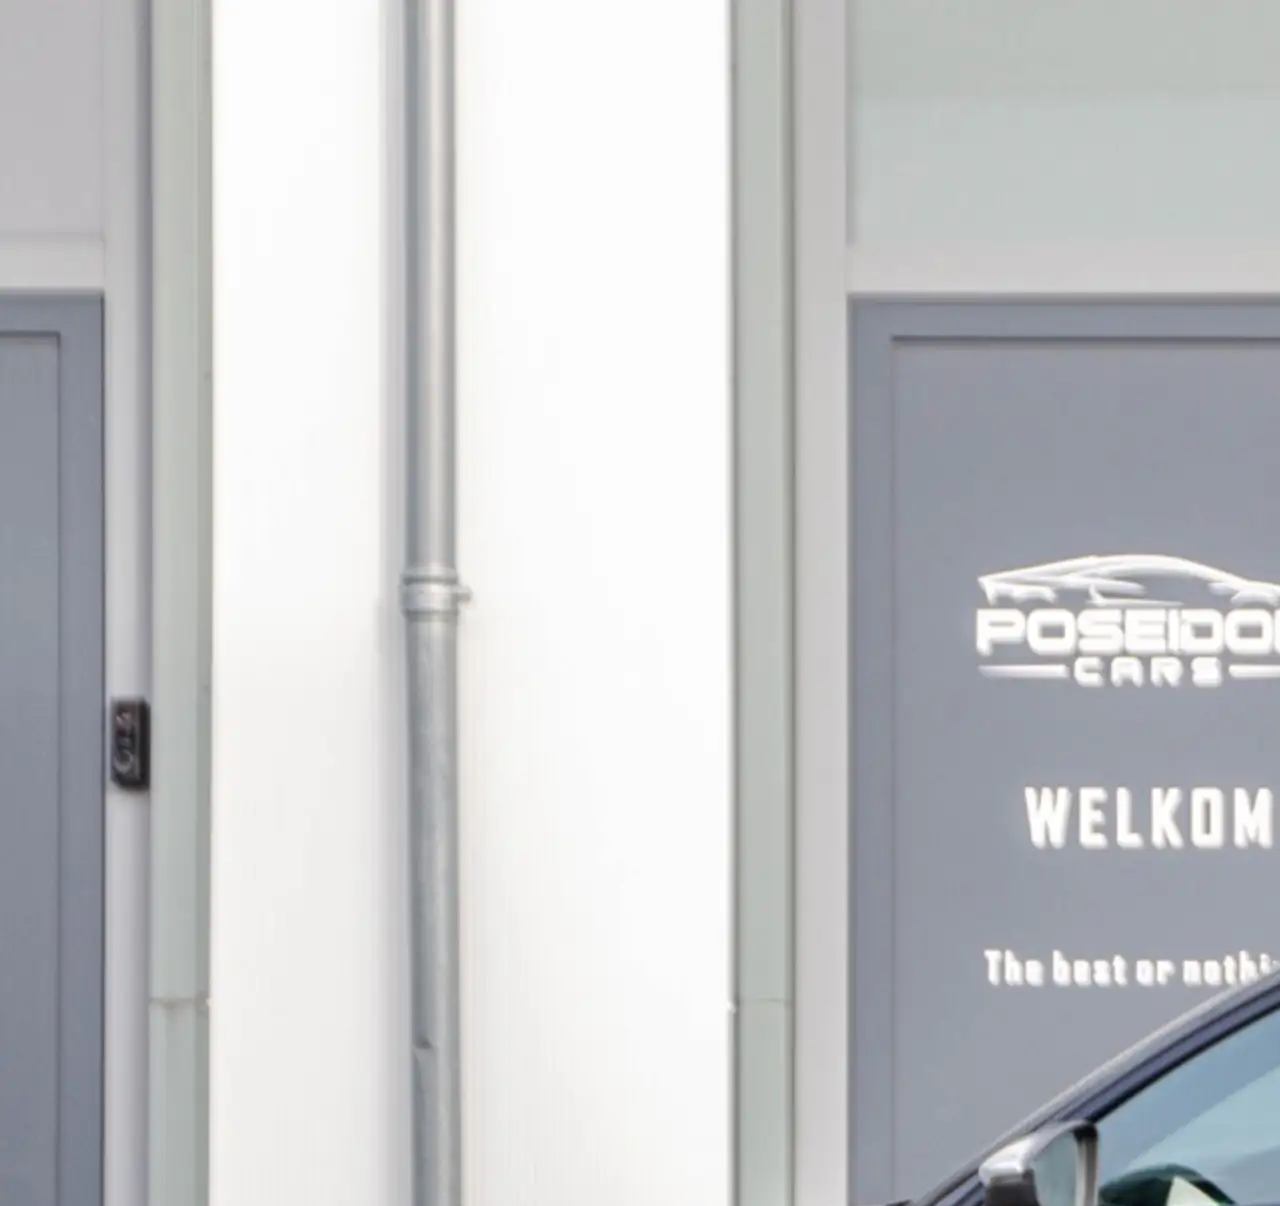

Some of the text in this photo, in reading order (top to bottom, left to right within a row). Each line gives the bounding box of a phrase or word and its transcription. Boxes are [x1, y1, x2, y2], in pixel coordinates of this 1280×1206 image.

[1074, 656, 1224, 687] CARS
[1024, 786, 1274, 849] WELKOM
[984, 950, 1044, 986] The
[1136, 959, 1175, 986] or
